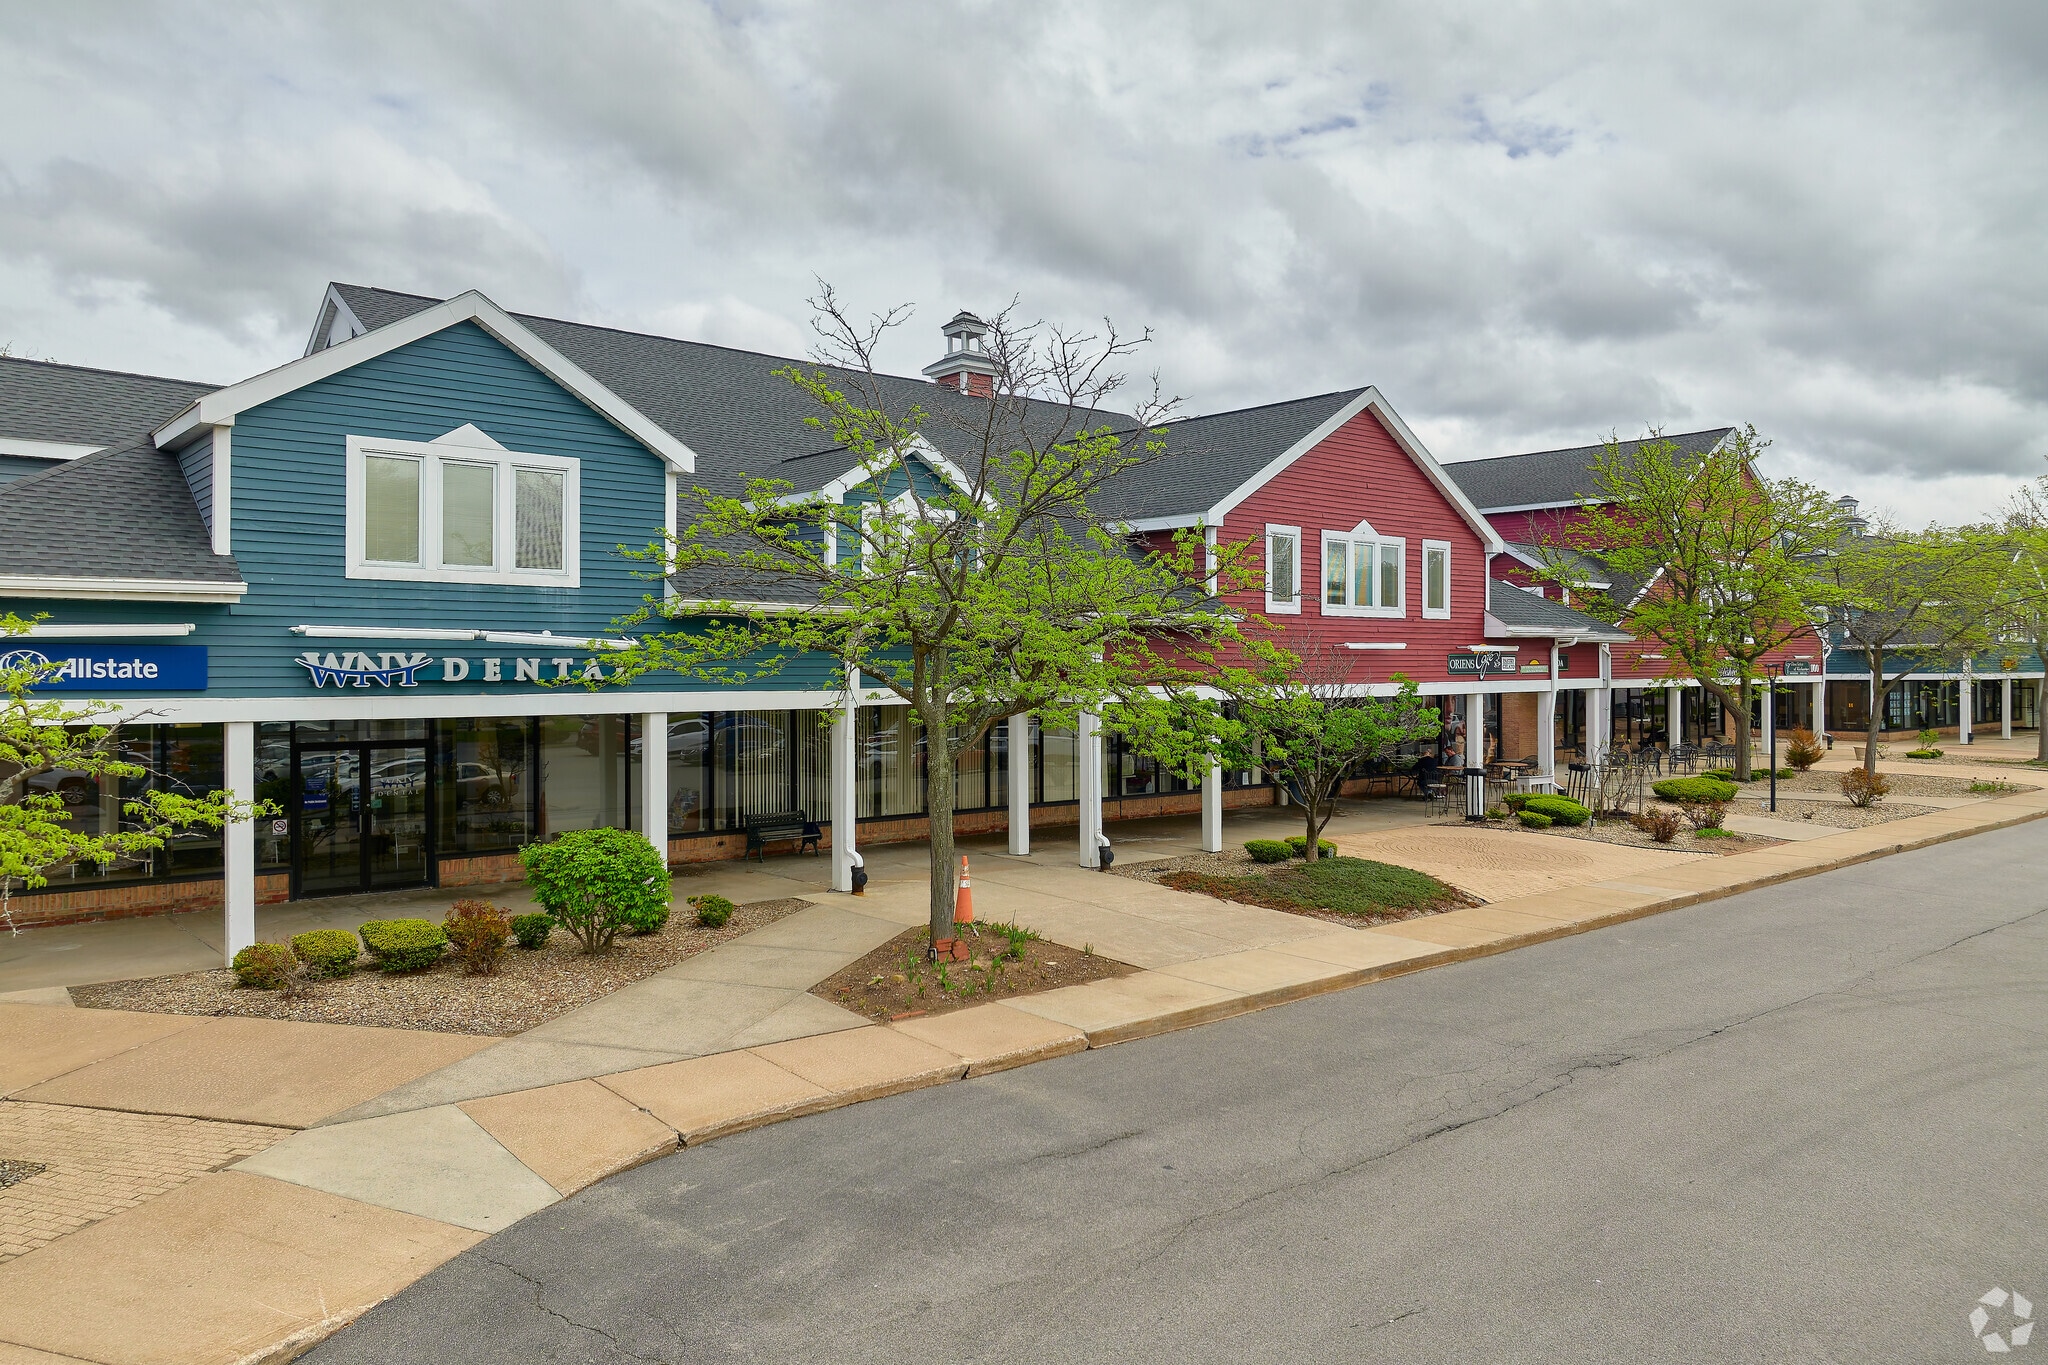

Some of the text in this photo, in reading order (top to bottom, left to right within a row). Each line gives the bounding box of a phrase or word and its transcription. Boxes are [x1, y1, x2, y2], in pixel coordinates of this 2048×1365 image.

[56, 658, 158, 679] Allstate
[300, 651, 428, 687] WNY
[1450, 660, 1475, 669] ORIENS
[378, 789, 420, 797] DENTAL
